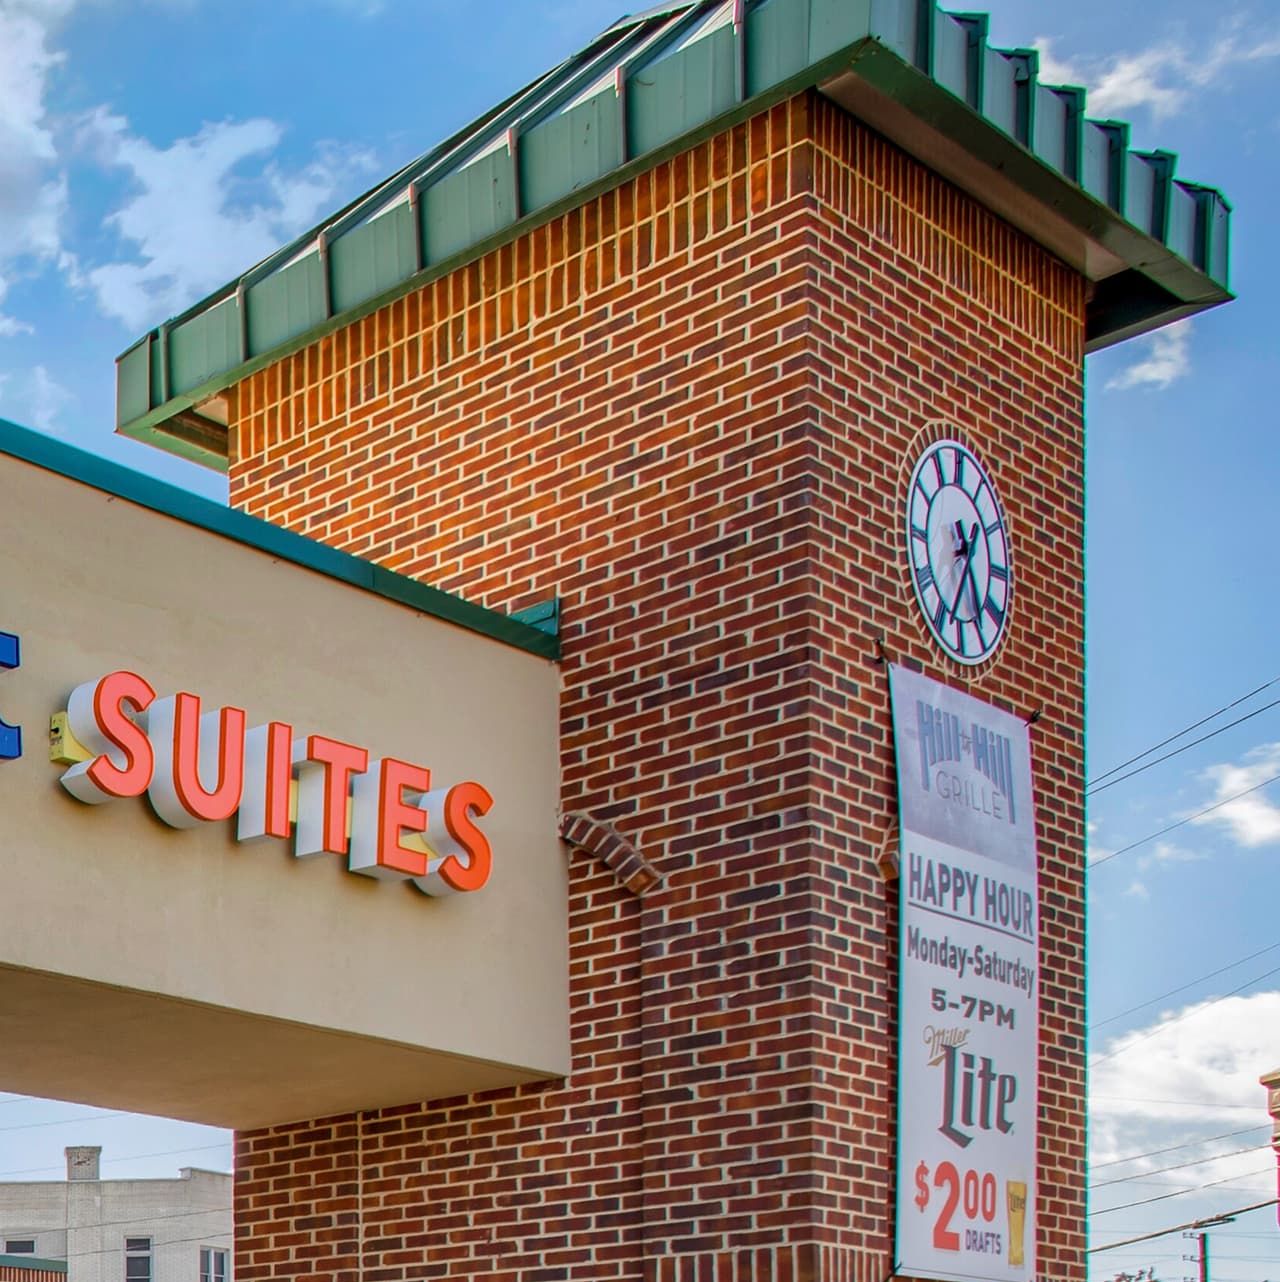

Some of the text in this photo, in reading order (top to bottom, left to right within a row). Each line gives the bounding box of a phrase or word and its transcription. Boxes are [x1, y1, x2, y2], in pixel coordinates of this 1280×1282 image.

[62, 670, 494, 894] SUITES
[916, 700, 961, 792] Hill
[971, 723, 1016, 824] Hill
[936, 770, 1002, 819] GRILLE
[908, 852, 1033, 936] HAPPY HOUR
[907, 925, 1035, 999] Monday-Saturday
[931, 987, 1016, 1030] 5-7PM
[938, 1044, 1017, 1148] Lite
[964, 1229, 1001, 1255] DRAFTS
